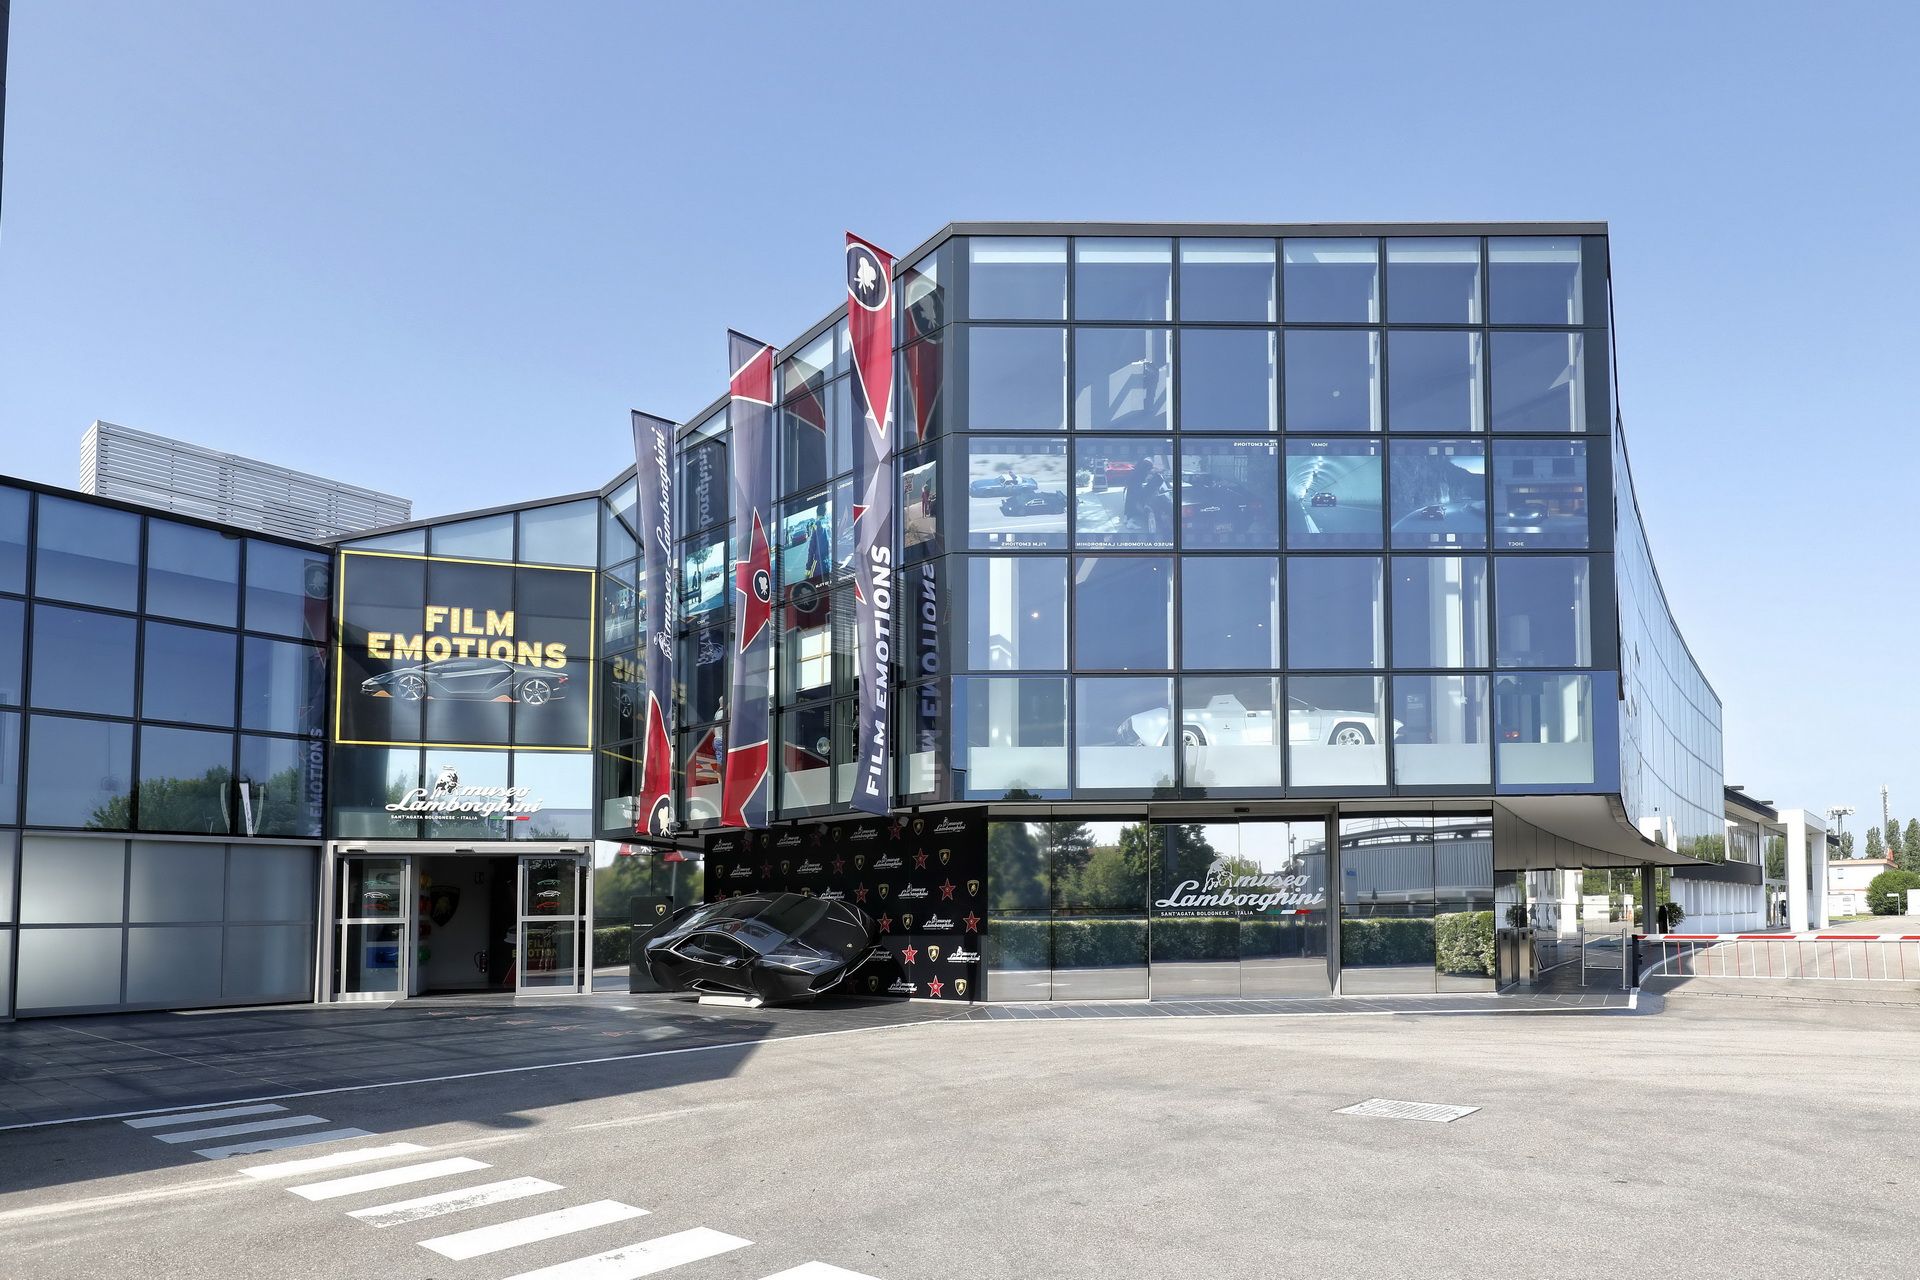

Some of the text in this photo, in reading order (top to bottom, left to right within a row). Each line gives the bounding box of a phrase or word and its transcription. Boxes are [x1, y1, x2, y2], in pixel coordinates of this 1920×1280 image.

[651, 426, 672, 567] Lamborghini
[426, 604, 514, 636] FILM
[368, 631, 567, 668] EMOTIONS
[866, 544, 891, 796] FILM EMOTIONS
[385, 788, 544, 817] Lamborghini
[458, 785, 530, 797] museo
[1155, 880, 1325, 912] Lamborghini
[1234, 874, 1311, 887] museo
